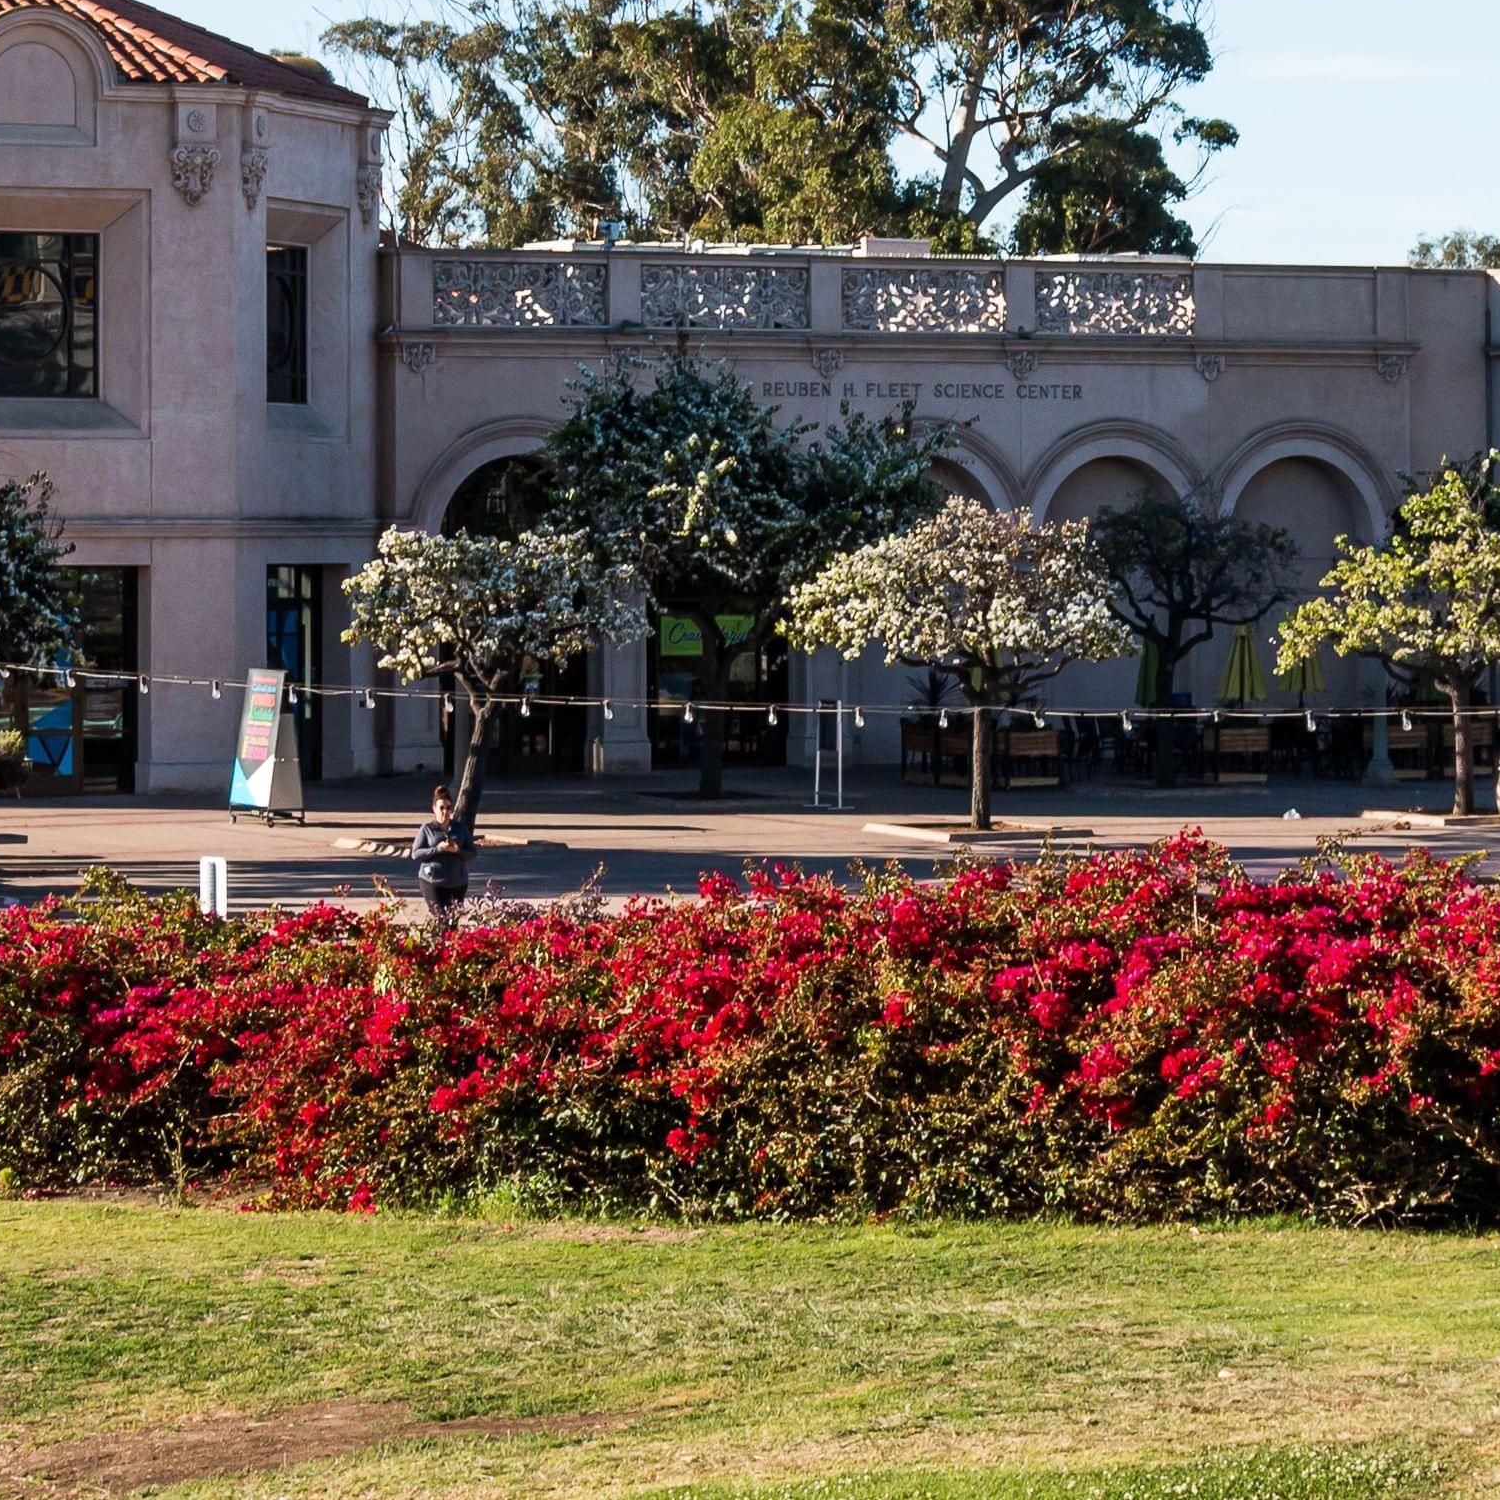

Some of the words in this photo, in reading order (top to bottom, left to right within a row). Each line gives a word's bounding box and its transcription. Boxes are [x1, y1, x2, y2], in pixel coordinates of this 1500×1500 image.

[762, 382, 831, 397] REUBEN
[843, 382, 858, 398] H.
[866, 383, 923, 398] FLEET
[933, 383, 1005, 399] SCIENCE
[1016, 384, 1083, 400] CENTER
